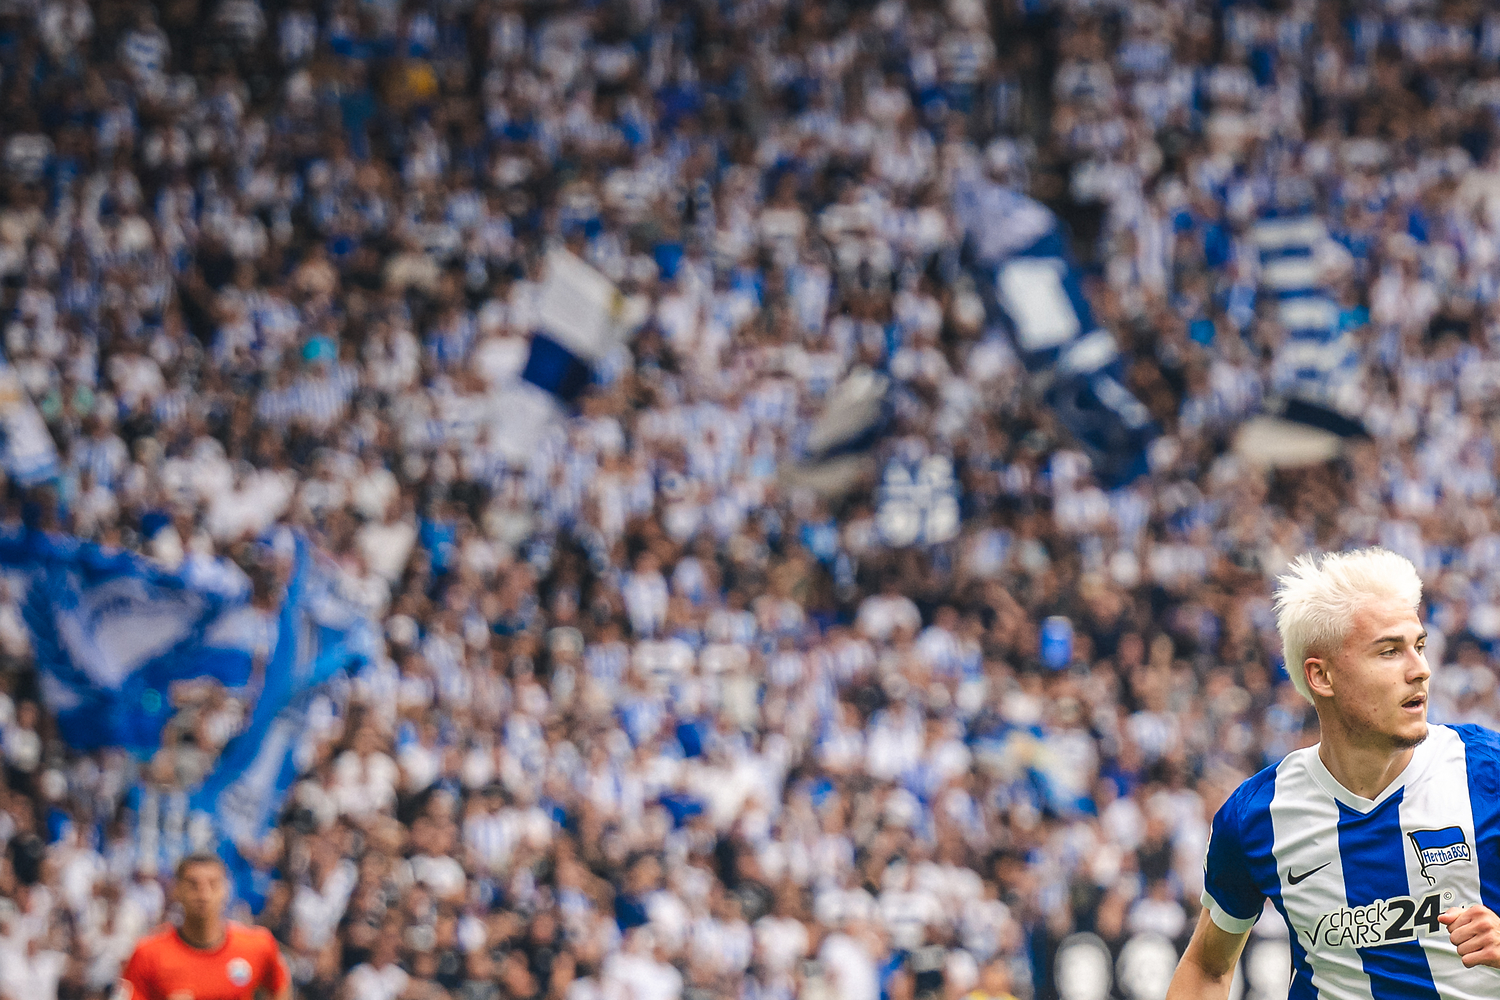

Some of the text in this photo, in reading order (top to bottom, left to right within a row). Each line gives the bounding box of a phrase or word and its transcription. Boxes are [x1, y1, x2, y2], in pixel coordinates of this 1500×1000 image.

[1324, 923, 1381, 946] CARS
[1330, 894, 1441, 941] check 24
